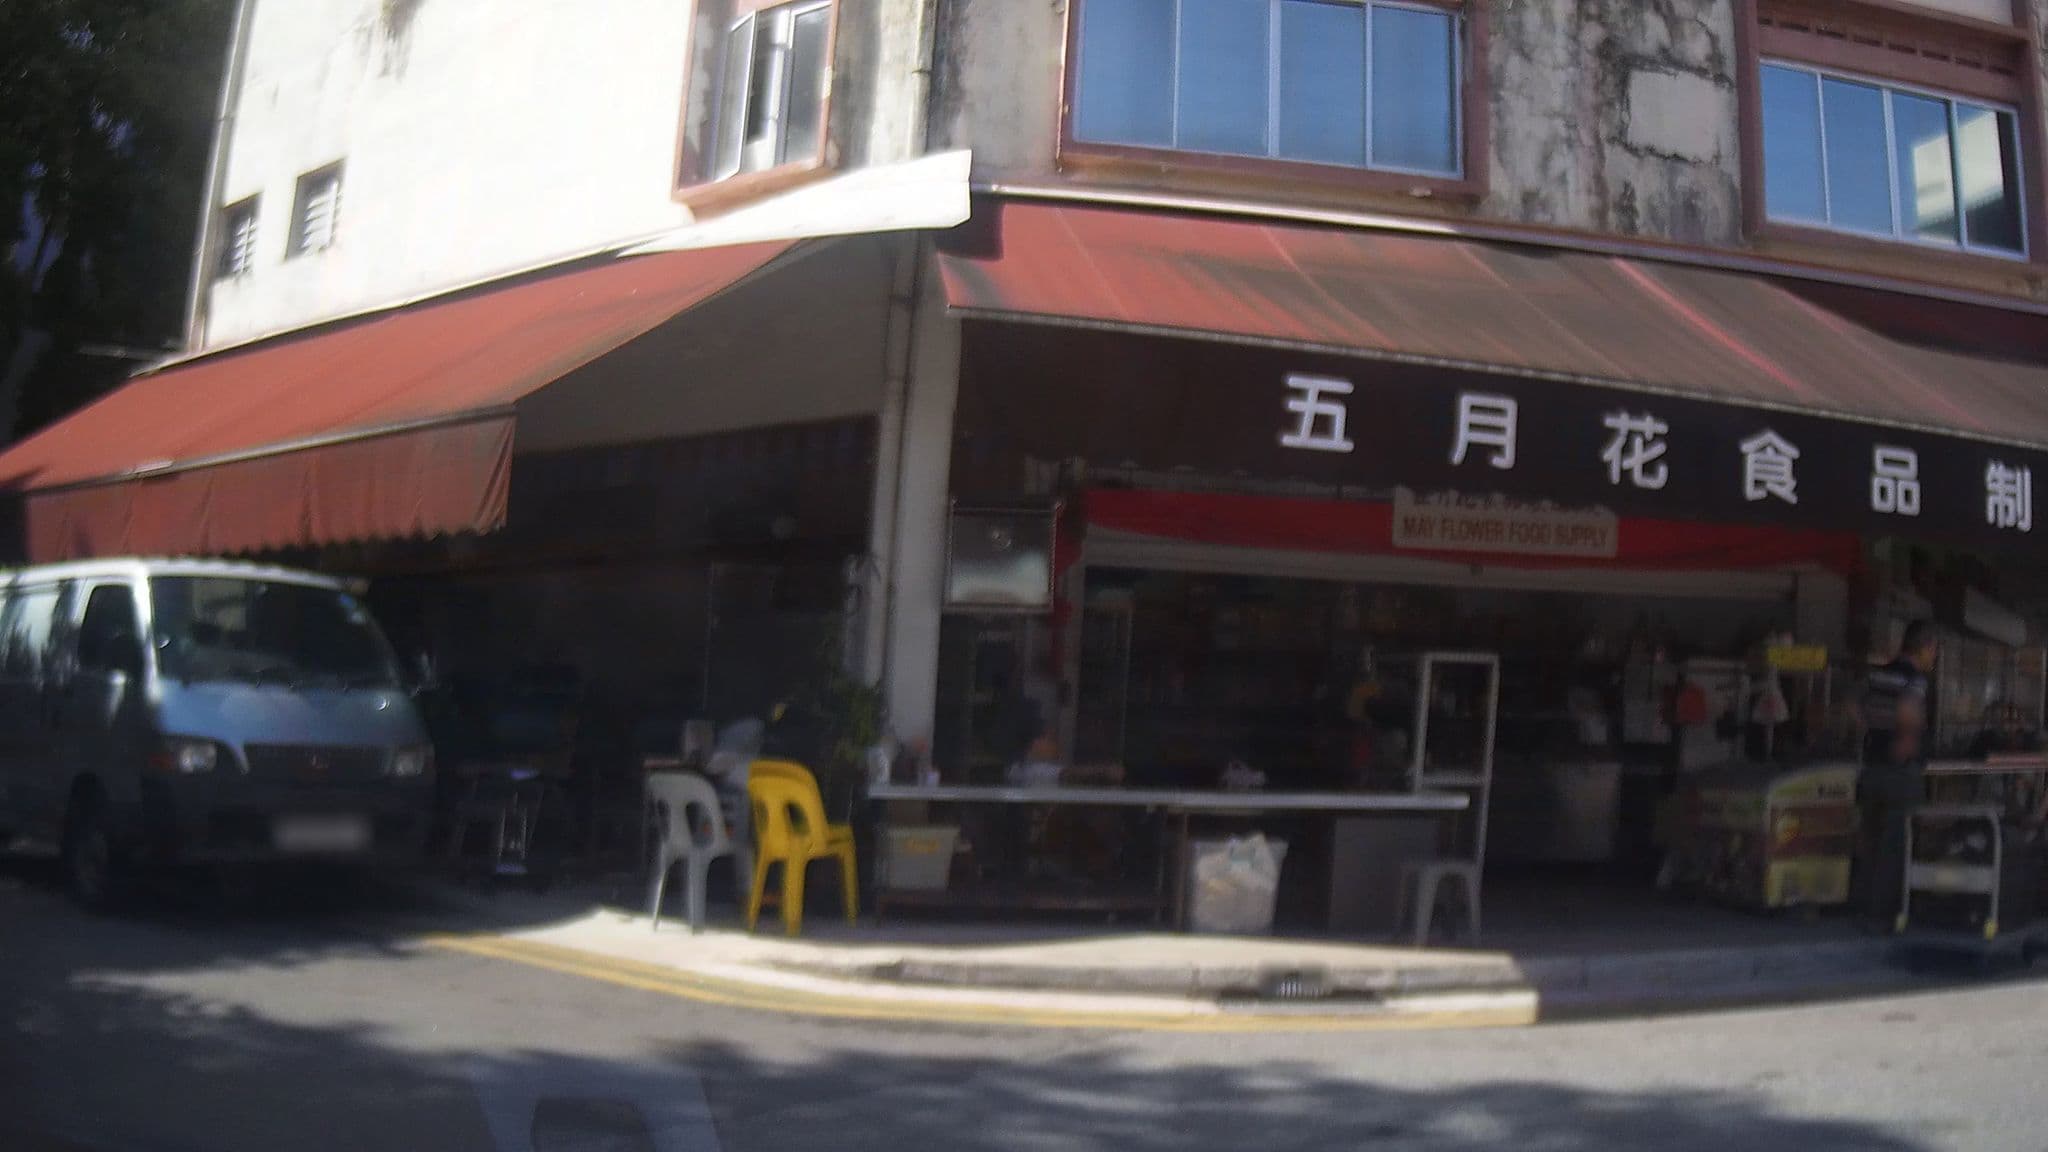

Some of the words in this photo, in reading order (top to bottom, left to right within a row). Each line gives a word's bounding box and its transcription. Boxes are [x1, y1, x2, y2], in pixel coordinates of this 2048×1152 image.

[1281, 375, 2032, 532] 五月花食品制
[1403, 517, 1434, 537] MAY
[1441, 518, 1503, 541] FLOWER
[1509, 520, 1550, 543] FOOD
[1556, 524, 1608, 546] SUPPLY
